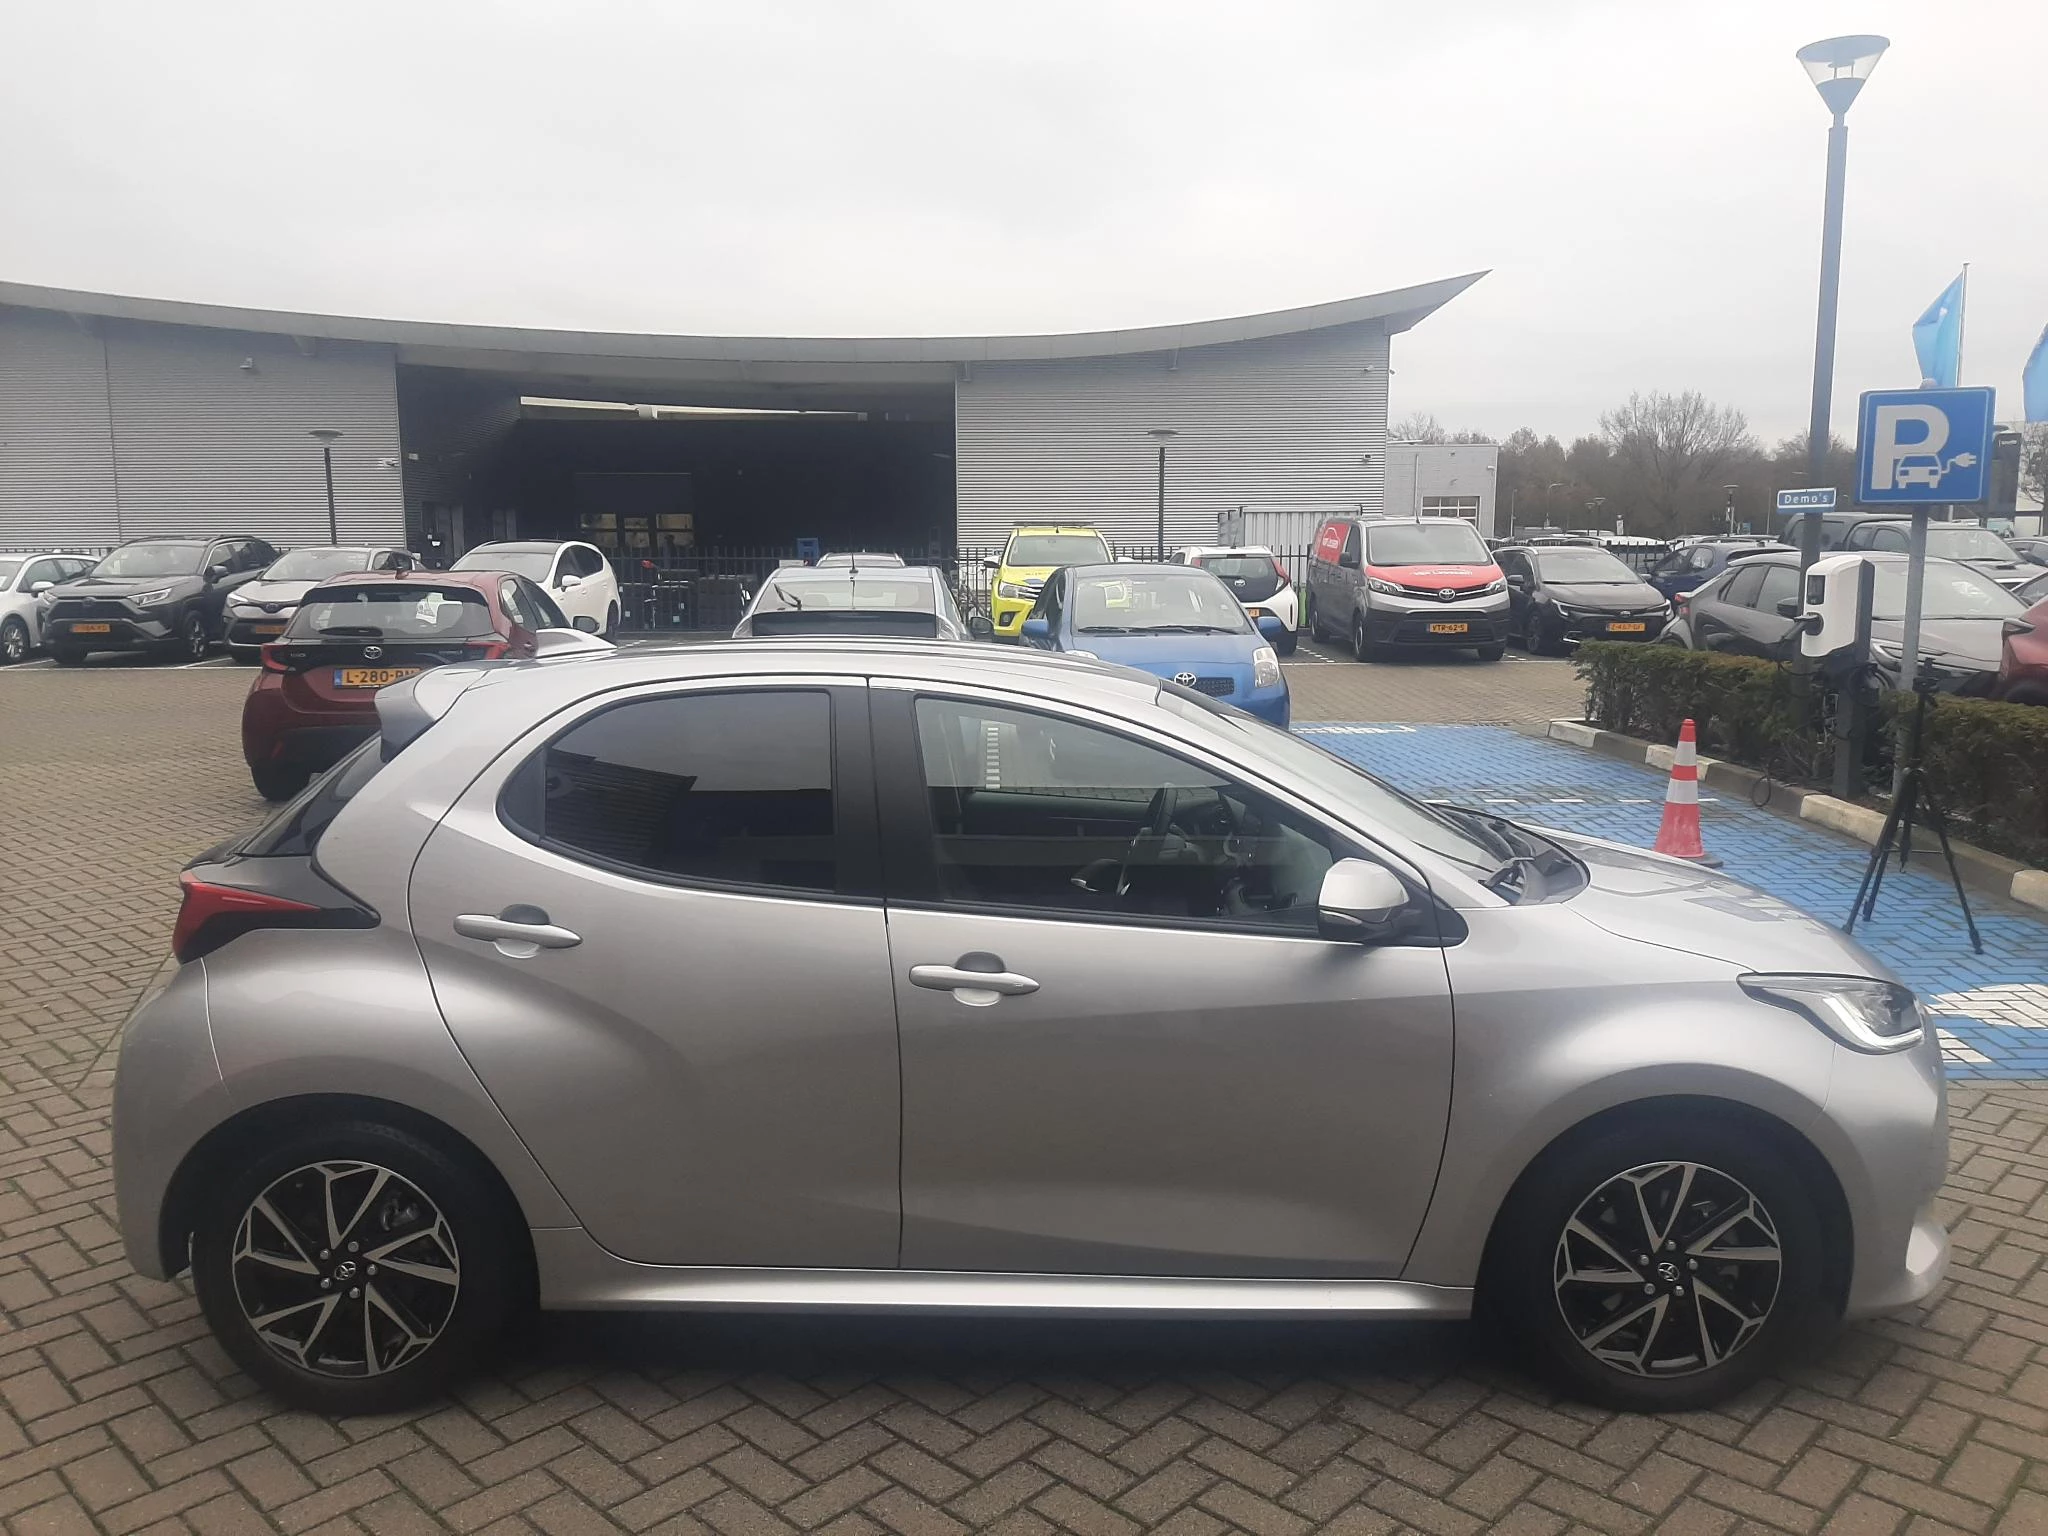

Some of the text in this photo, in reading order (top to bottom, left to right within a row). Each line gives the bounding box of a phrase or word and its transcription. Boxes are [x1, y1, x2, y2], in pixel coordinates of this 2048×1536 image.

[1871, 404, 1950, 490] P
[1784, 493, 1829, 504] Demo's
[346, 670, 416, 683] L-280-
